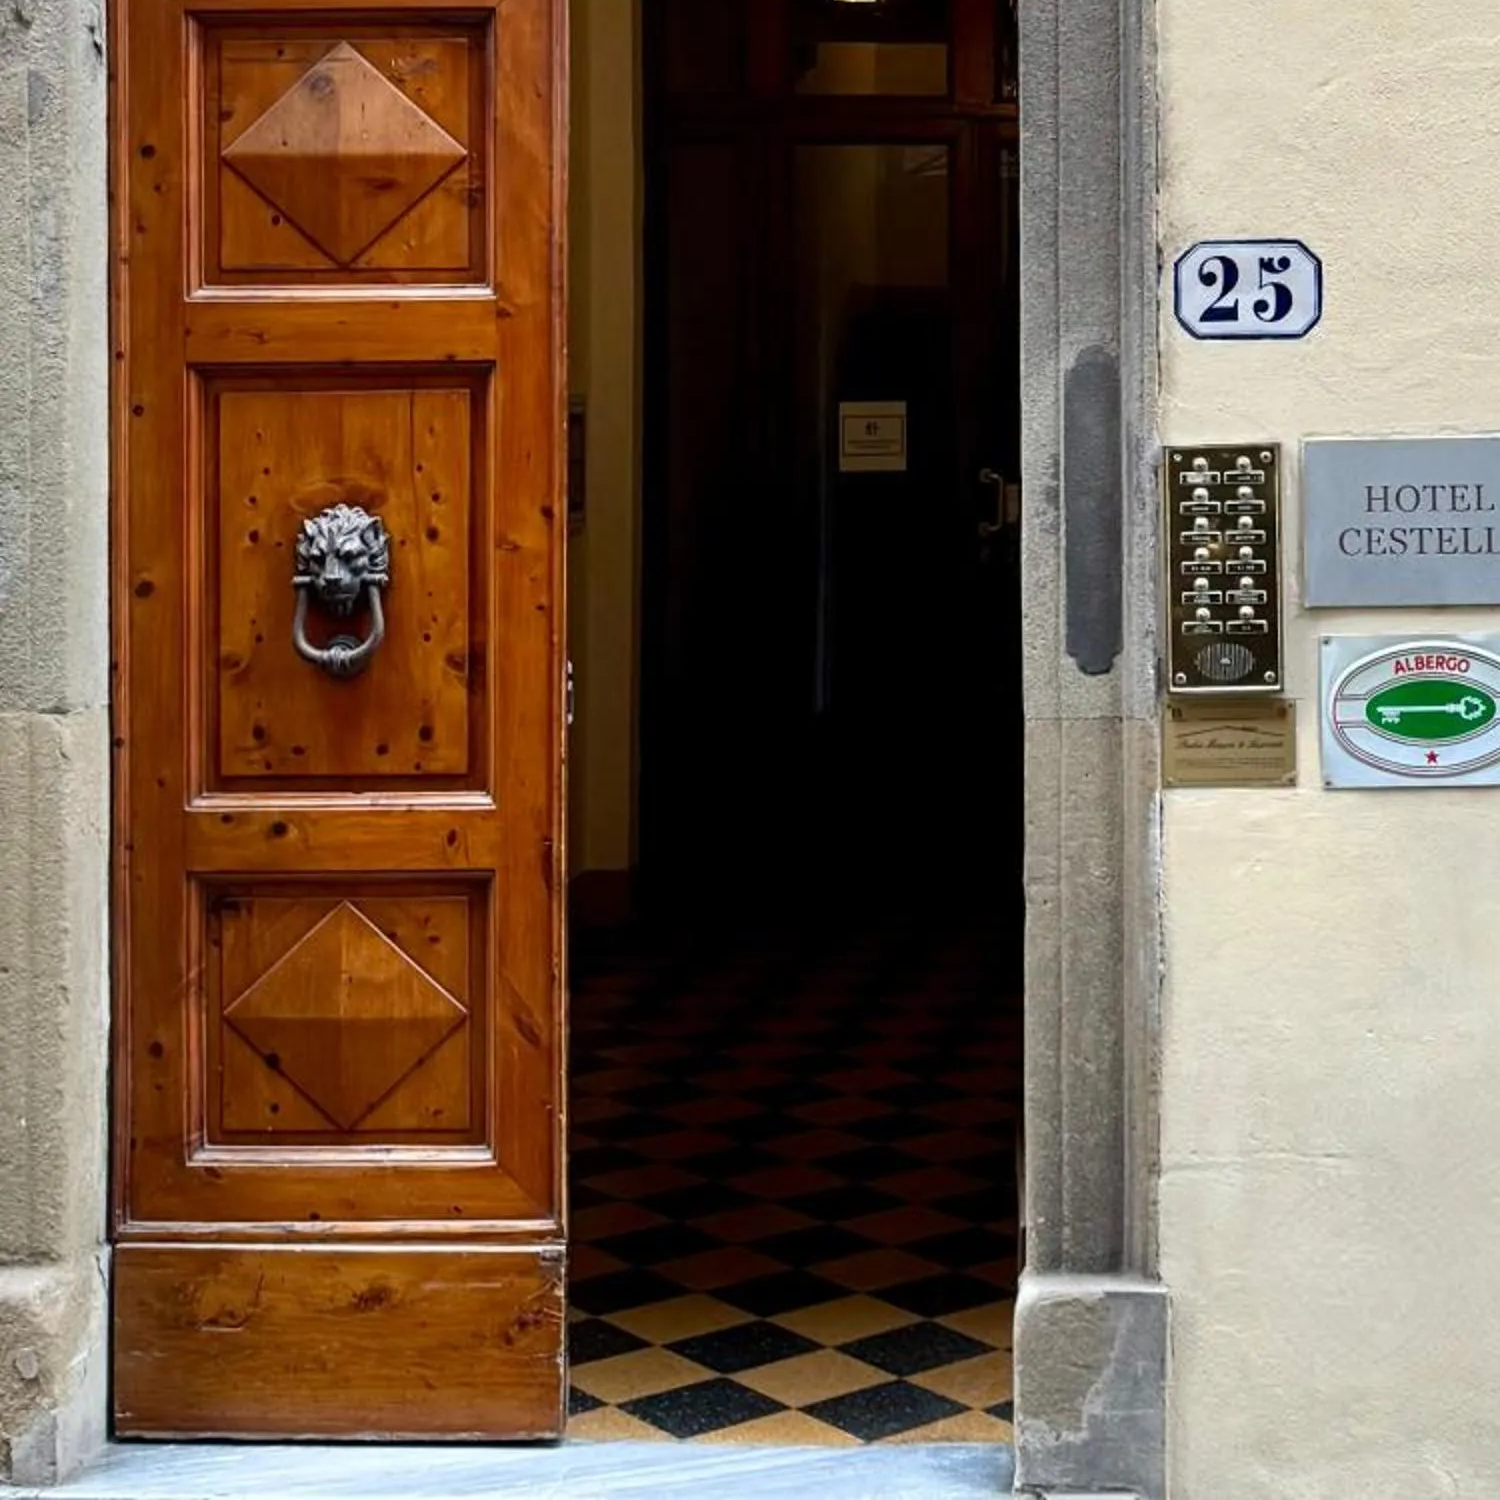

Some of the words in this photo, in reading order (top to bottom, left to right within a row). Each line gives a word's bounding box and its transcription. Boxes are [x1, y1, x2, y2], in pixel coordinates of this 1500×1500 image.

[1197, 255, 1294, 322] 25
[1364, 484, 1496, 514] HOTEL
[1394, 655, 1471, 675] ALBERGO
